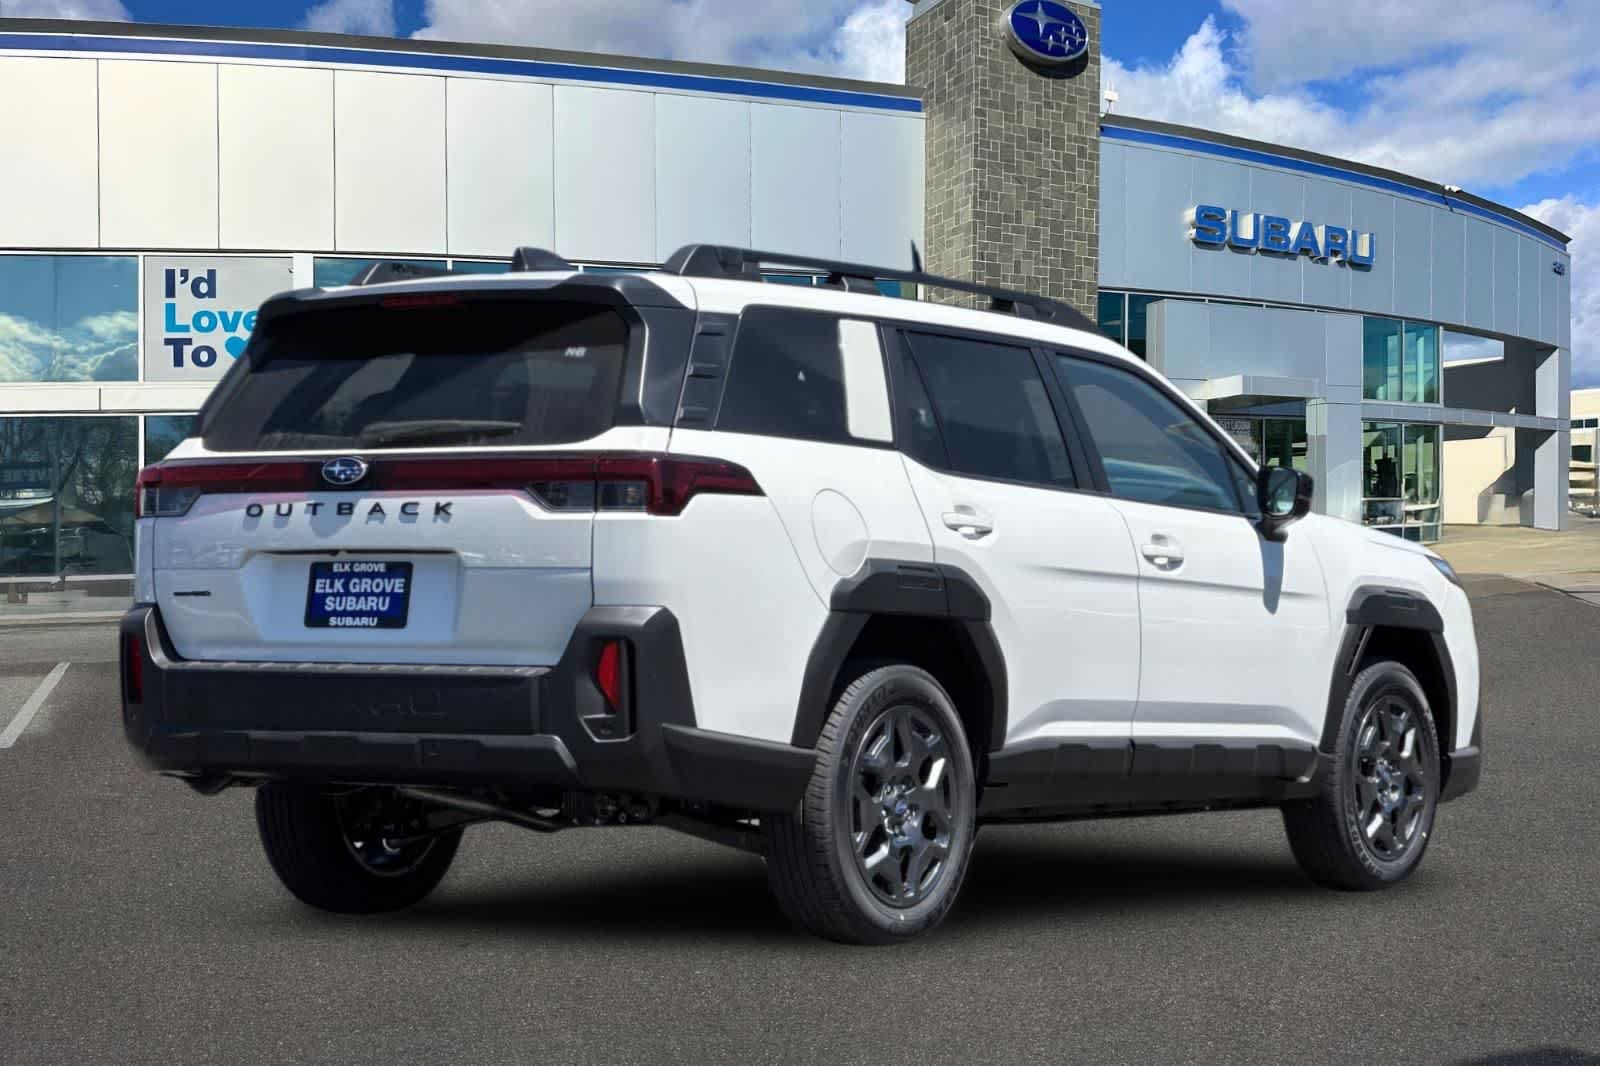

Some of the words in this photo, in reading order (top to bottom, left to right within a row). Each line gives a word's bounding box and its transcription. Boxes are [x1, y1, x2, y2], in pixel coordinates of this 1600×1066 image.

[1191, 204, 1376, 267] SUBARU
[164, 338, 217, 368] To
[245, 501, 454, 518] OUTBACK
[333, 563, 351, 573] ELK
[353, 563, 386, 573] GROVE
[315, 578, 345, 593] ELK
[349, 578, 405, 593] GROVE
[324, 596, 390, 611] SUBARU
[328, 617, 378, 626] SUBARU
